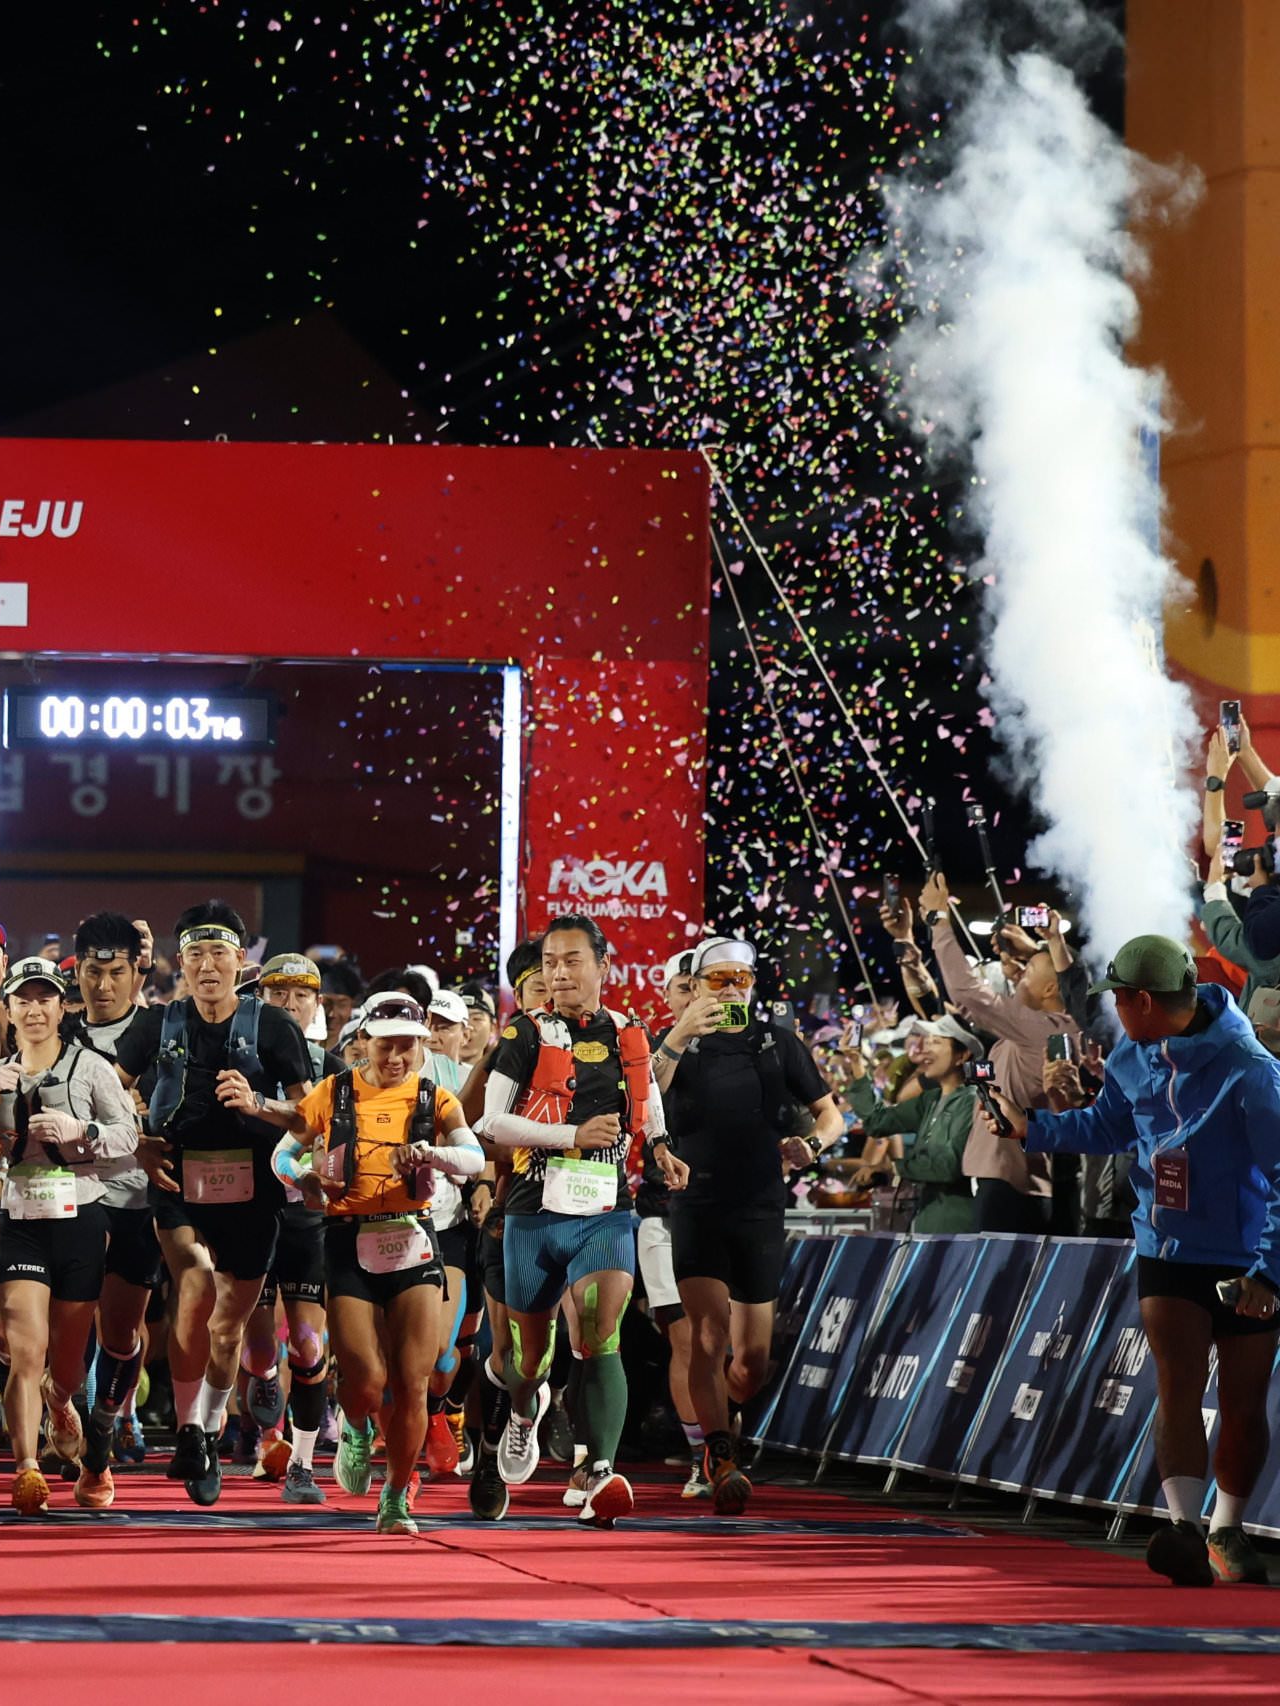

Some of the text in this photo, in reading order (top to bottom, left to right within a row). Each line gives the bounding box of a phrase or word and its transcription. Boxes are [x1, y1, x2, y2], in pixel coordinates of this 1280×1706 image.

[547, 859, 669, 897] HOKA
[546, 902, 573, 916] FLY
[576, 903, 638, 918] HUMAN
[201, 1174, 235, 1185] 1670
[1159, 1178, 1182, 1190] MEDIA
[369, 1213, 392, 1222] China
[17, 1263, 46, 1274] TERREX
